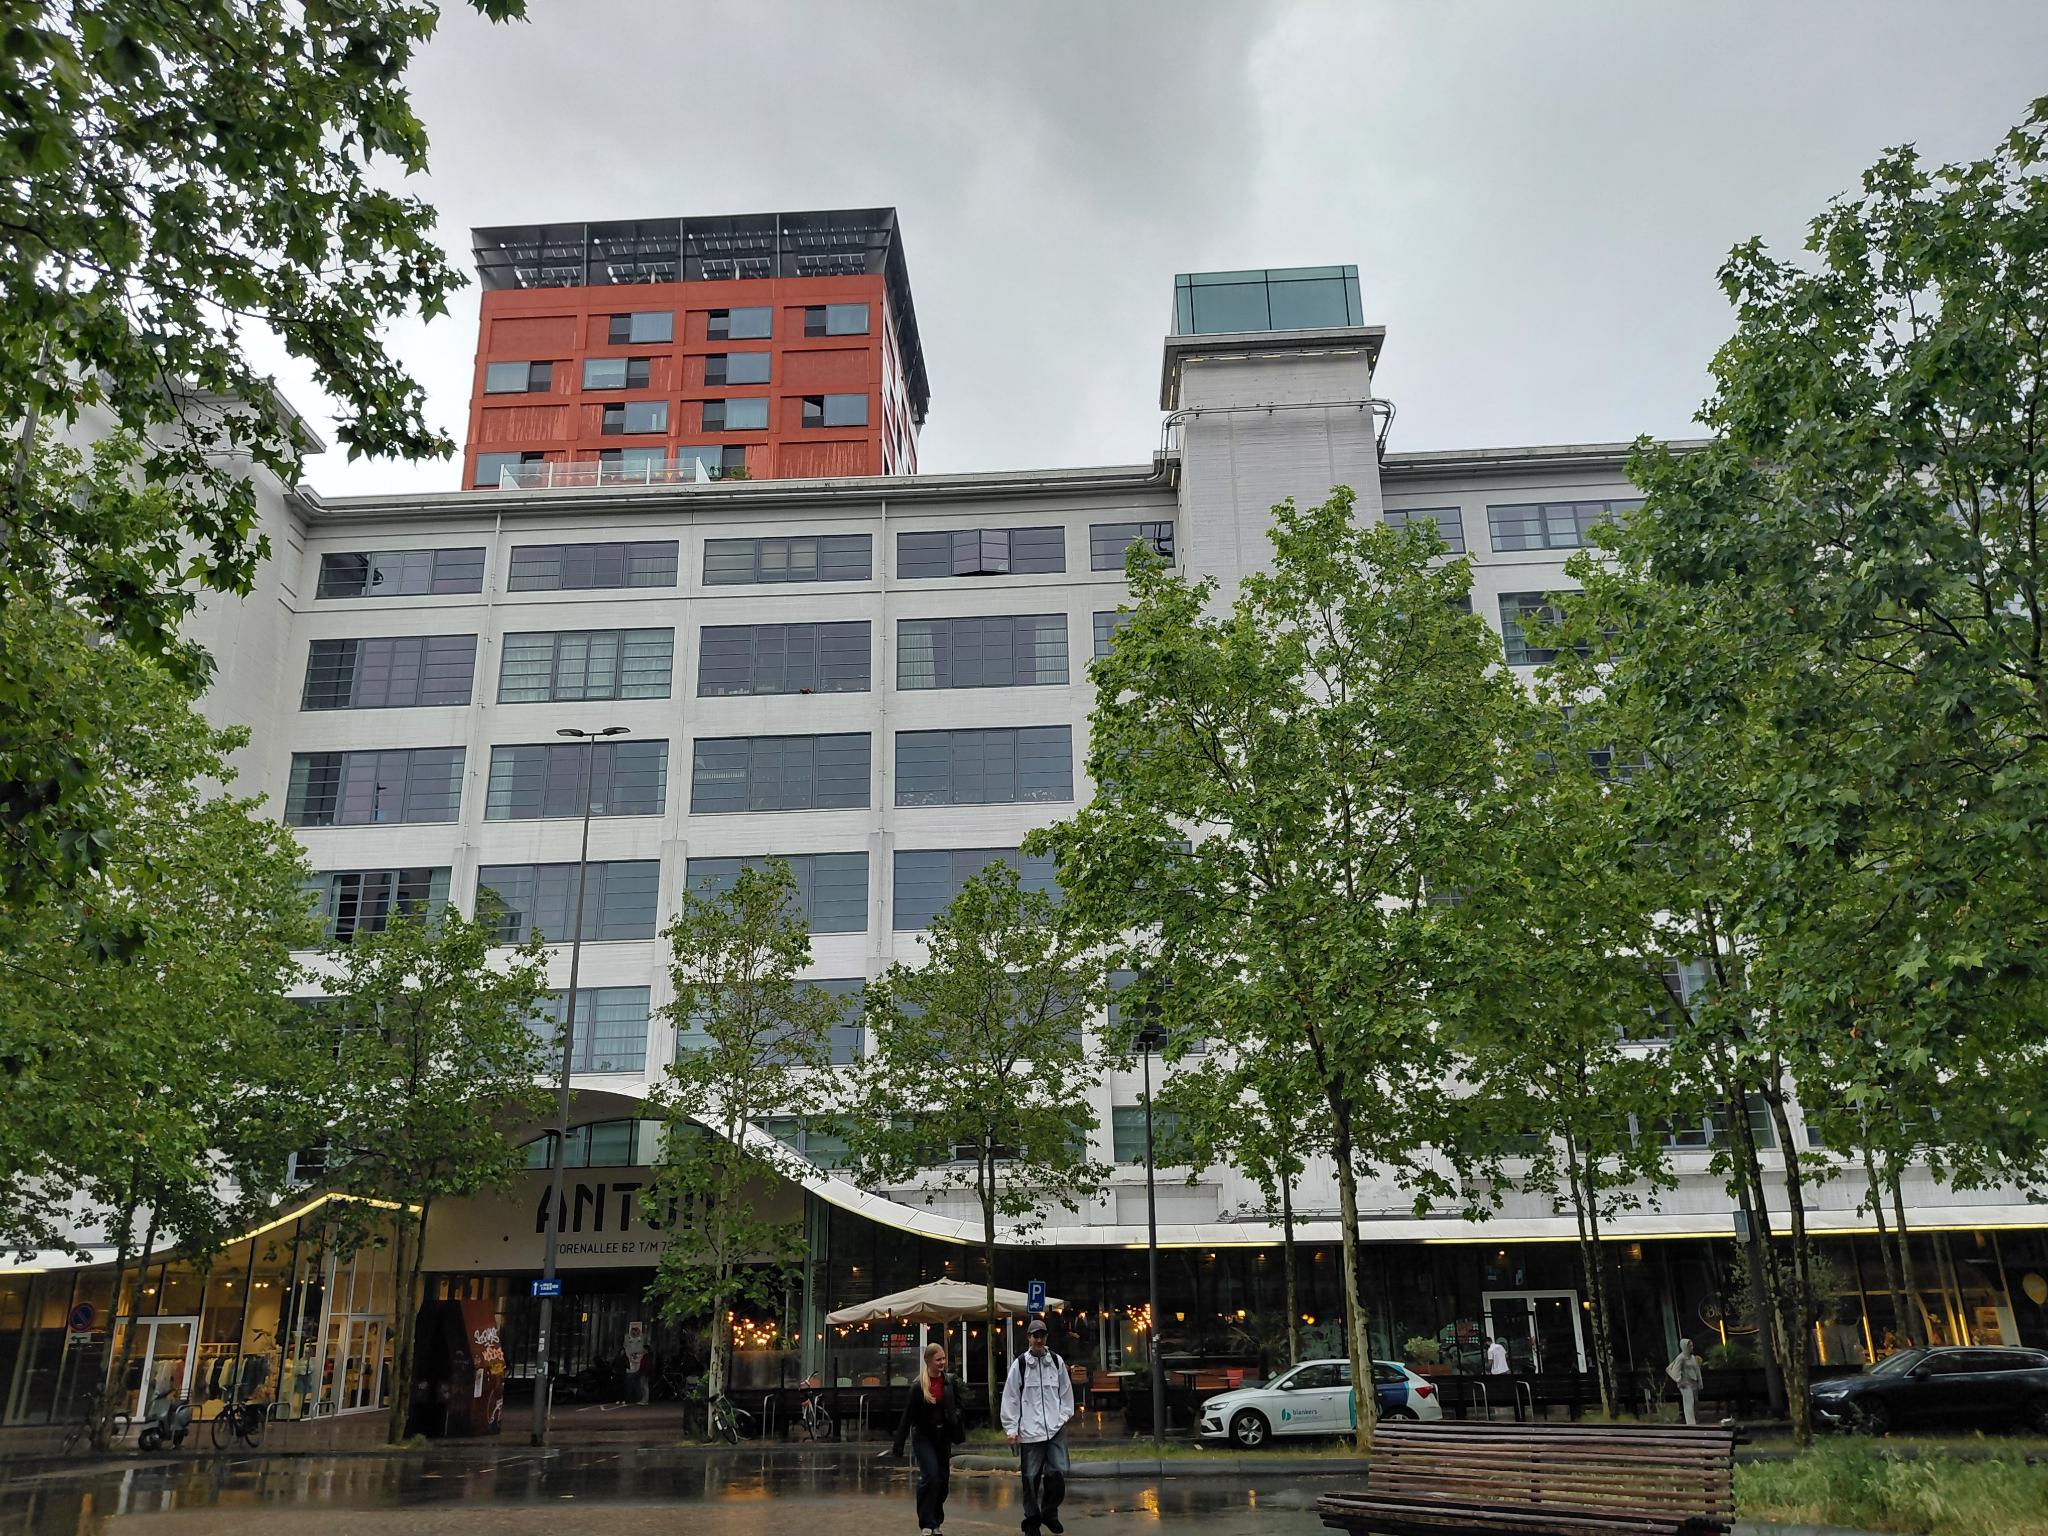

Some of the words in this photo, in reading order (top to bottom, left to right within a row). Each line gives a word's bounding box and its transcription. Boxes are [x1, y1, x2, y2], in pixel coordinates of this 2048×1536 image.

[557, 1242, 619, 1254] ORENALLEE
[621, 1242, 635, 1253] 62
[639, 1241, 658, 1253] T/M
[1032, 1284, 1042, 1301] P
